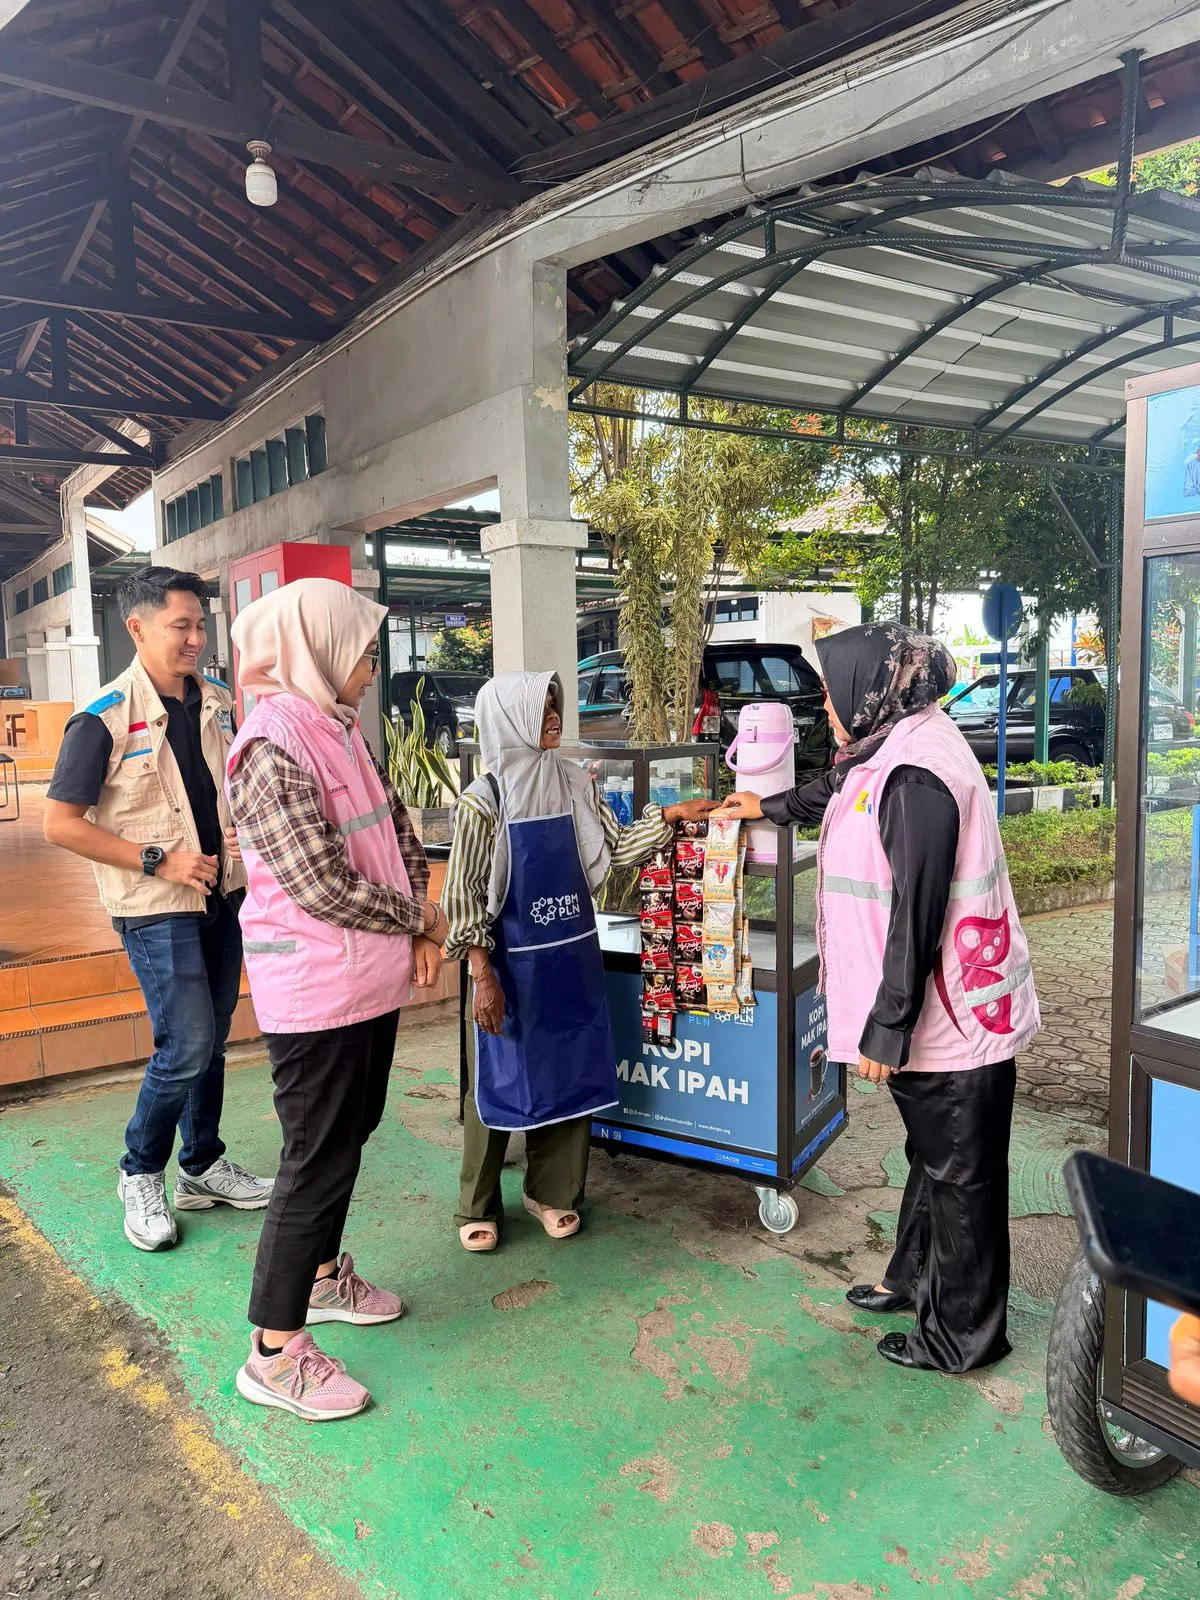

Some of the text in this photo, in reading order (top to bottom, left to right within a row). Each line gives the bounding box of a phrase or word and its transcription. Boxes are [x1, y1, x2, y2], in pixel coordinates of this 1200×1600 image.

[555, 893, 579, 906] YBM
[559, 903, 580, 917] PLN
[688, 1015, 710, 1026] PLN
[735, 1014, 754, 1024] PLN
[809, 1003, 825, 1026] KOPI
[801, 1019, 827, 1050] MAK IPA
[615, 1059, 749, 1105] MAK IPAH
[216, 1178, 238, 1195] N
